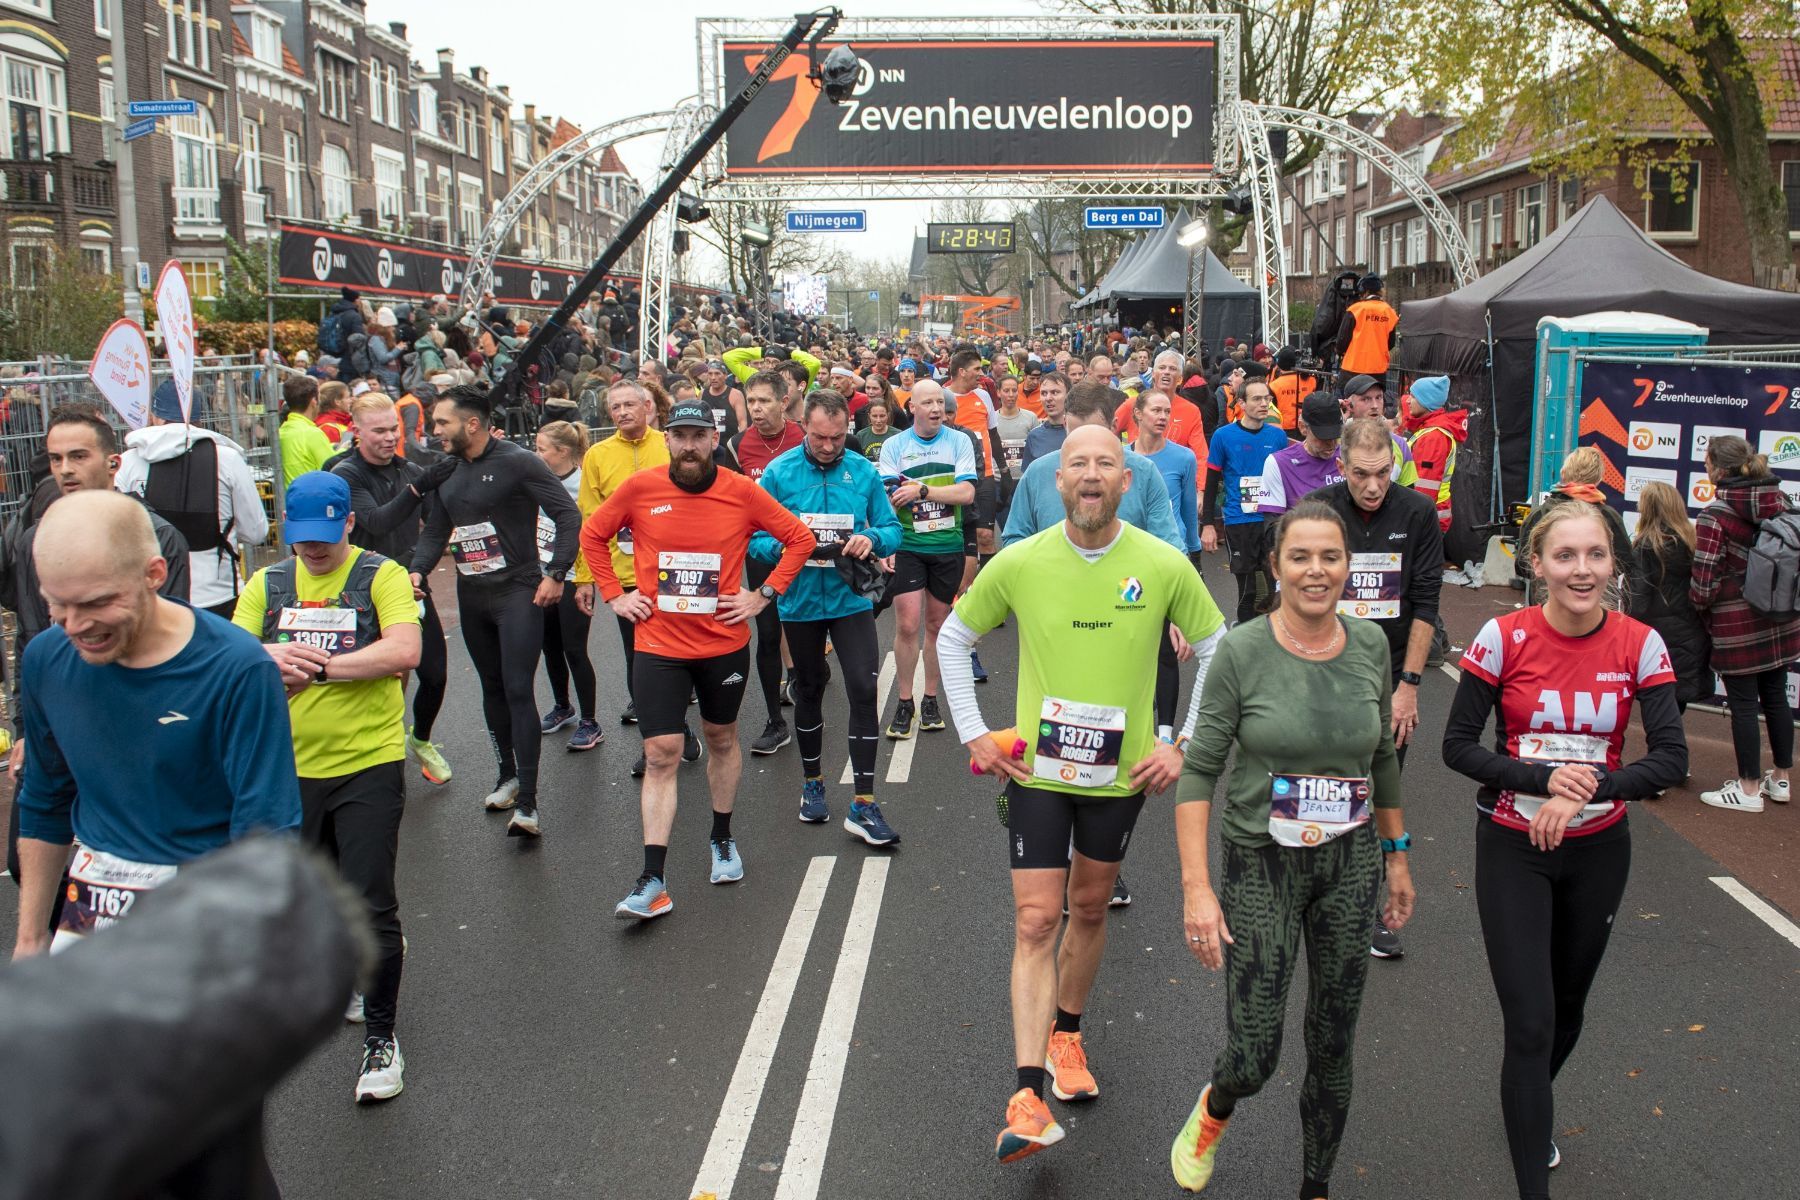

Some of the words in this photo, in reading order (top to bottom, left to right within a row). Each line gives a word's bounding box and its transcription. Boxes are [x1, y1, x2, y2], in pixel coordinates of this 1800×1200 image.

[762, 48, 789, 77] Motion
[879, 69, 905, 83] NN
[133, 102, 191, 112] Sumatrastraat
[838, 96, 1193, 138] Zevenheuvelenloop
[794, 214, 857, 229] Nijmegen
[1091, 212, 1118, 224] Berg
[1121, 214, 1136, 222] en
[1140, 211, 1158, 222] Dal
[333, 253, 347, 269] NN
[393, 262, 405, 277] NN
[1654, 391, 1749, 409] Zevenheuvelenloop
[674, 407, 703, 419] HOKA
[1658, 436, 1676, 447] NN
[1782, 442, 1798, 454] AA
[650, 504, 672, 515] HOKA
[461, 539, 487, 553] 5881
[674, 570, 704, 585] 7097
[1352, 572, 1383, 588] 9761
[679, 585, 699, 596] RICK
[1356, 588, 1380, 599] TWAN
[1072, 620, 1113, 630] Rogier
[293, 631, 338, 650] 13972
[1058, 725, 1105, 749] 13776
[1060, 745, 1098, 763] ROGIER
[1296, 777, 1352, 802] 11054
[87, 885, 135, 917] 7762
